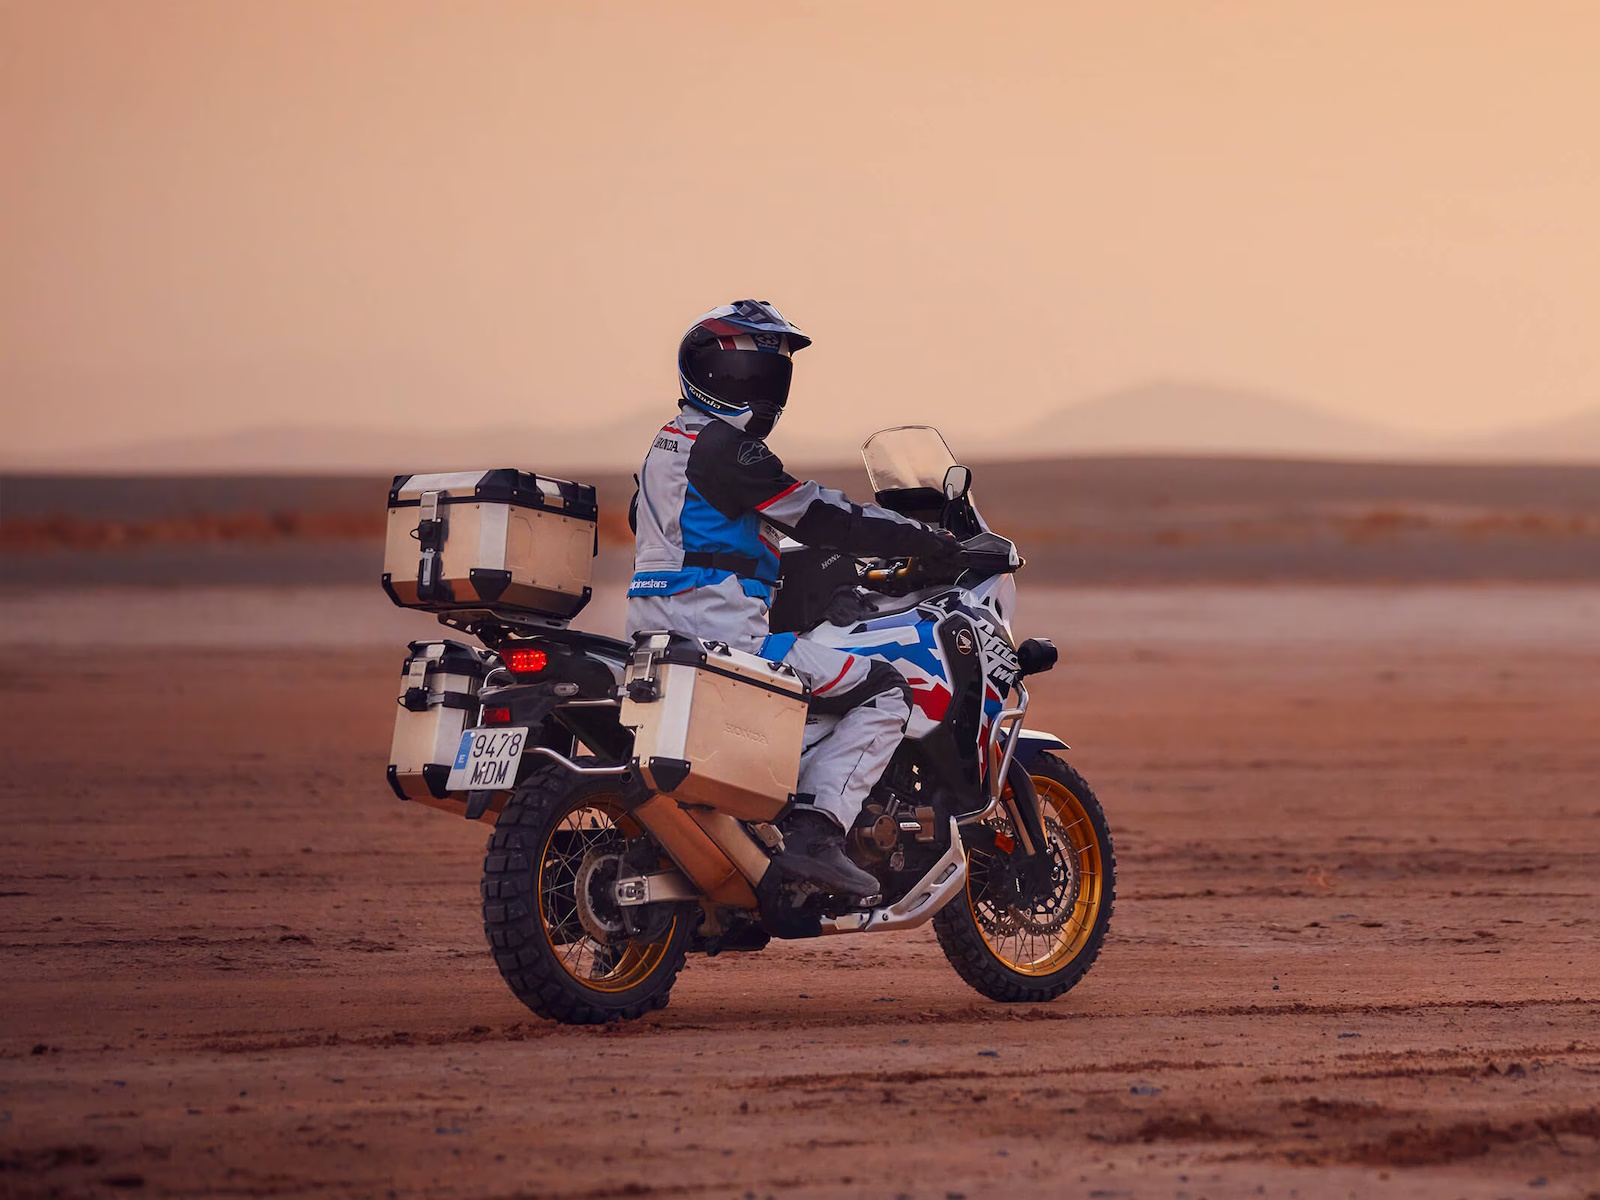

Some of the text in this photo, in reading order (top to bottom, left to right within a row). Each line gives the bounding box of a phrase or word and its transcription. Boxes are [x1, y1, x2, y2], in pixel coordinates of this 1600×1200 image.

[473, 733, 522, 758] 9478
[721, 723, 769, 745] HONDA
[458, 754, 466, 763] E
[470, 760, 510, 785] MDM
